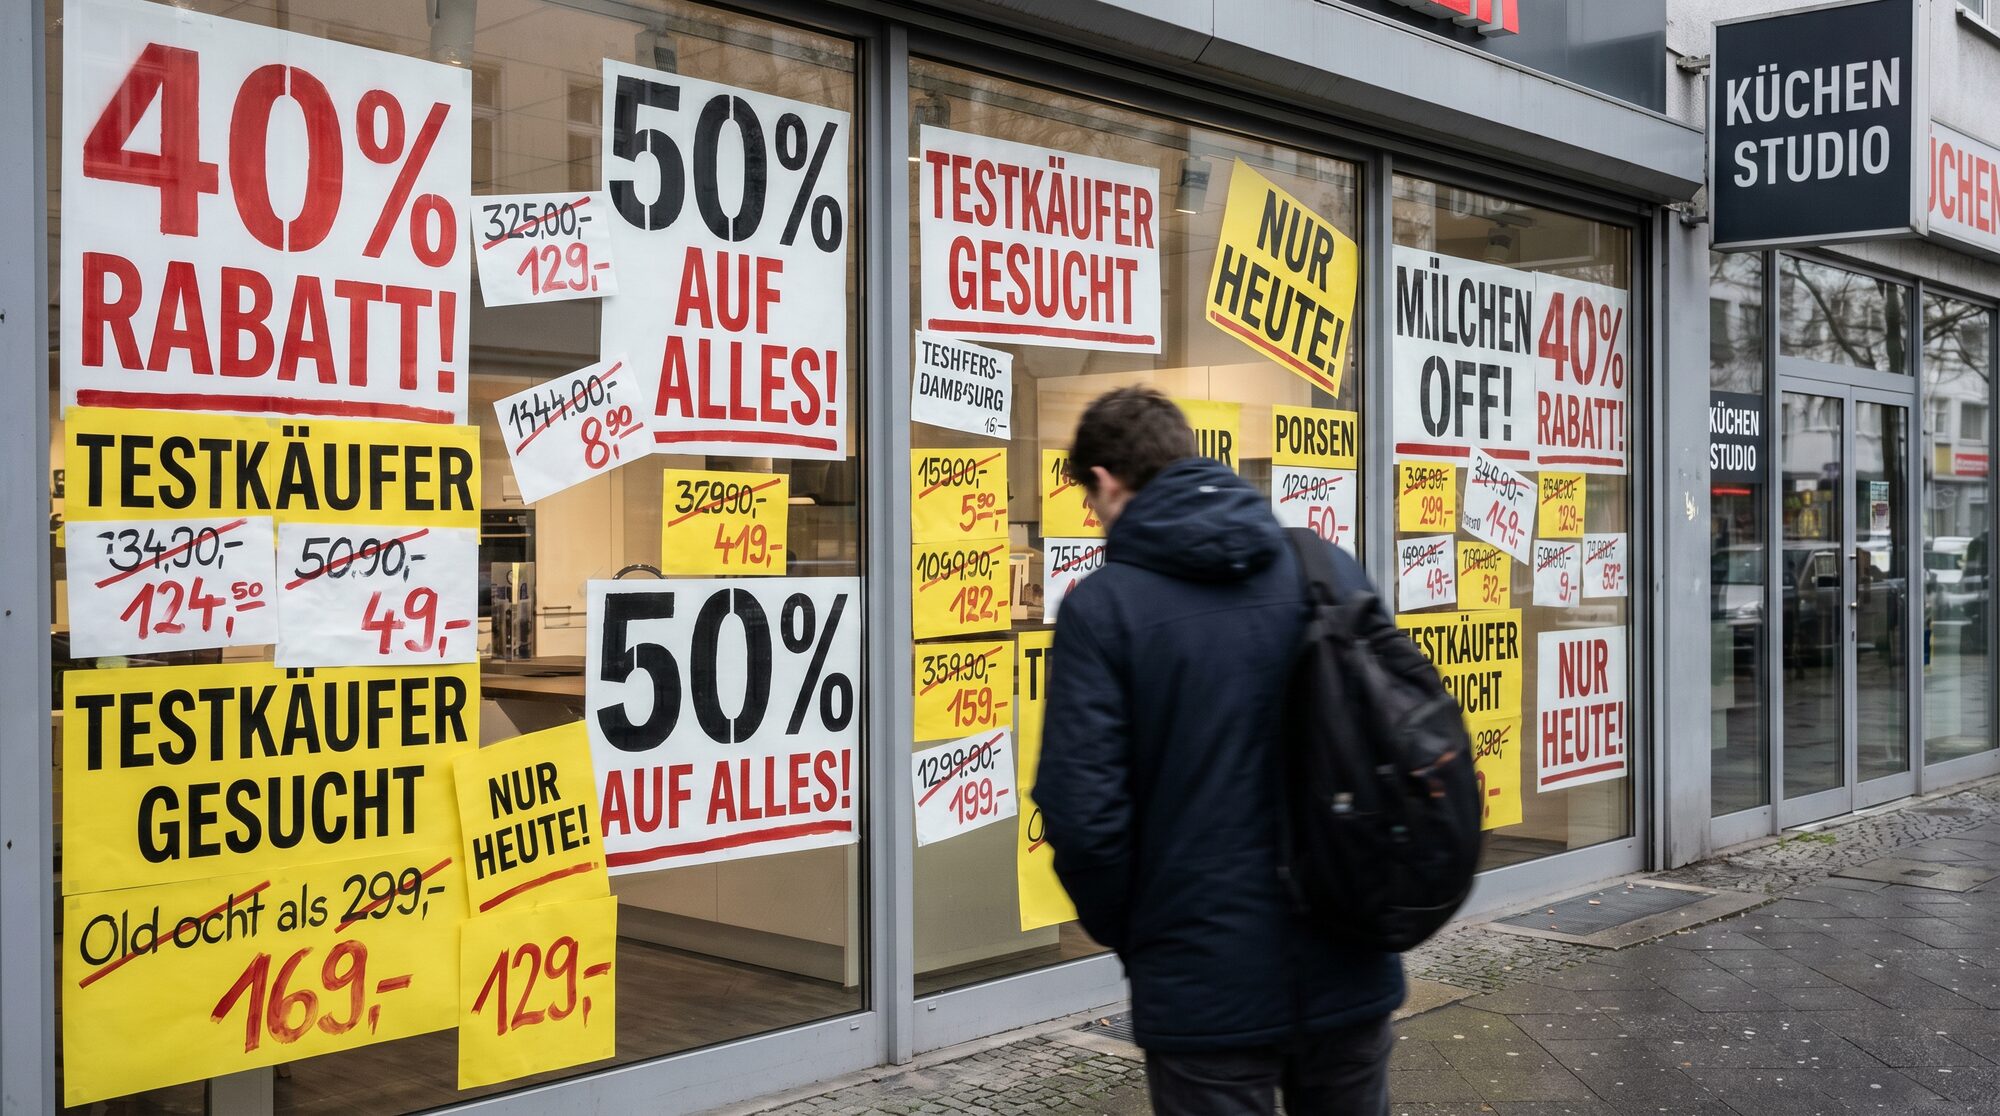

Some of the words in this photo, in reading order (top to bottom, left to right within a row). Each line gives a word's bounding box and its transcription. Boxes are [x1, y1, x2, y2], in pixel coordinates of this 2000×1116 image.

[1726, 57, 1900, 126] KÜCHEN
[83, 42, 457, 268] 40%
[609, 75, 843, 252] 50%
[1733, 125, 1890, 188] STUDIO
[926, 150, 1154, 249] TESTKÄUFER
[1256, 189, 1335, 293] NUR
[82, 252, 457, 393] RABATT!
[674, 246, 784, 334] AUF
[949, 236, 1138, 324] GESUCHT
[1214, 244, 1345, 377] HEUTE!
[654, 336, 838, 427] ALLES!
[1538, 292, 1623, 389] 40%
[1276, 414, 1354, 457] PORSEN
[1420, 355, 1512, 441] OFF!
[1537, 391, 1623, 452] RABATT!
[1709, 401, 1759, 437] KÜCHEN
[76, 425, 474, 511] TESTKÄUFER
[1710, 442, 1756, 472] STUDIO
[714, 523, 783, 569] 419,-
[361, 586, 471, 658] 49,-
[1398, 614, 1519, 665] ESTKÄUFER
[597, 588, 853, 752] 50%
[946, 687, 1009, 728] 159,-
[1558, 638, 1609, 699] NUR
[75, 667, 470, 771] TESTKÄUFER
[1542, 701, 1625, 768] HEUTE!
[138, 764, 425, 864] GESUCHT
[488, 760, 561, 821] NUR
[600, 764, 693, 836] AUF
[706, 748, 851, 825] ALLES!
[949, 777, 1010, 825] 199,-
[472, 803, 591, 881] HEUTE!
[277, 883, 329, 933] als
[209, 939, 415, 1054] 169,-
[470, 935, 612, 1036] 129,-
